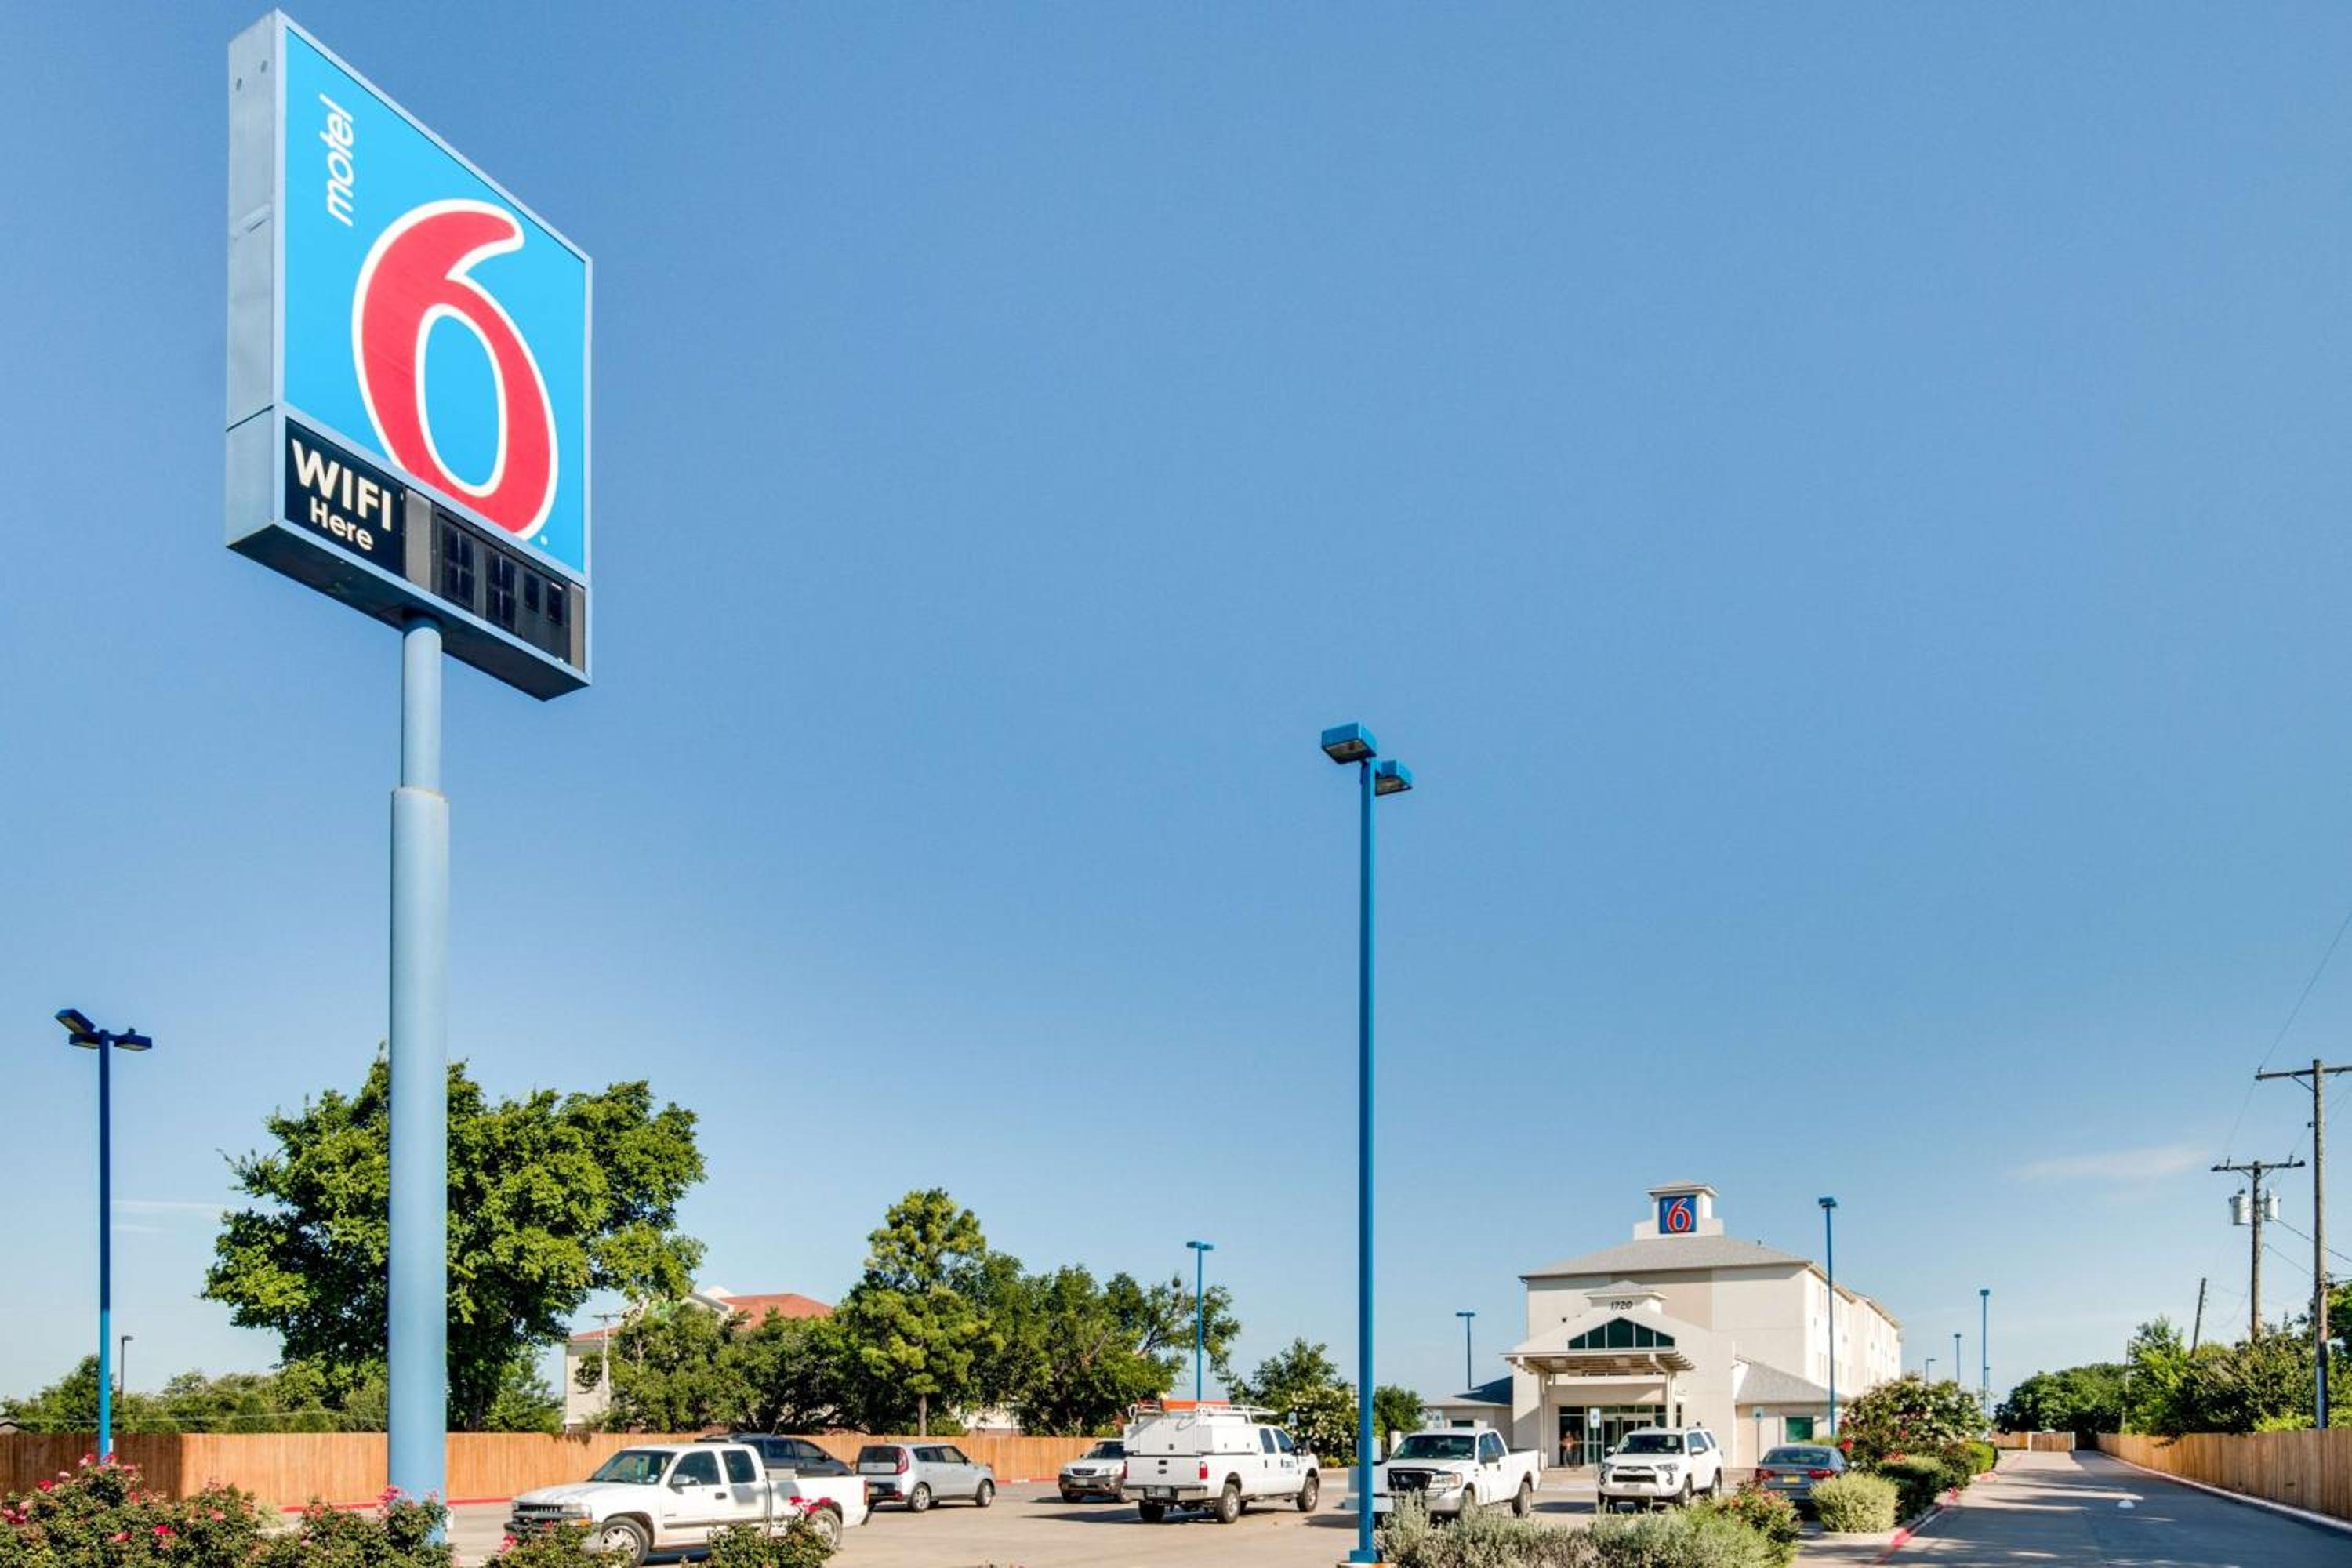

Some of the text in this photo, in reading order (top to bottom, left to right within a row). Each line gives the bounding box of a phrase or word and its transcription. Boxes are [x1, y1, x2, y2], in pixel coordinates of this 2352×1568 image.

[319, 93, 354, 226] motel
[351, 198, 558, 541] 6
[292, 438, 392, 532] WIFI
[310, 496, 374, 551] Here
[1667, 1197, 1692, 1232] 6
[1611, 1301, 1633, 1310] 1720
